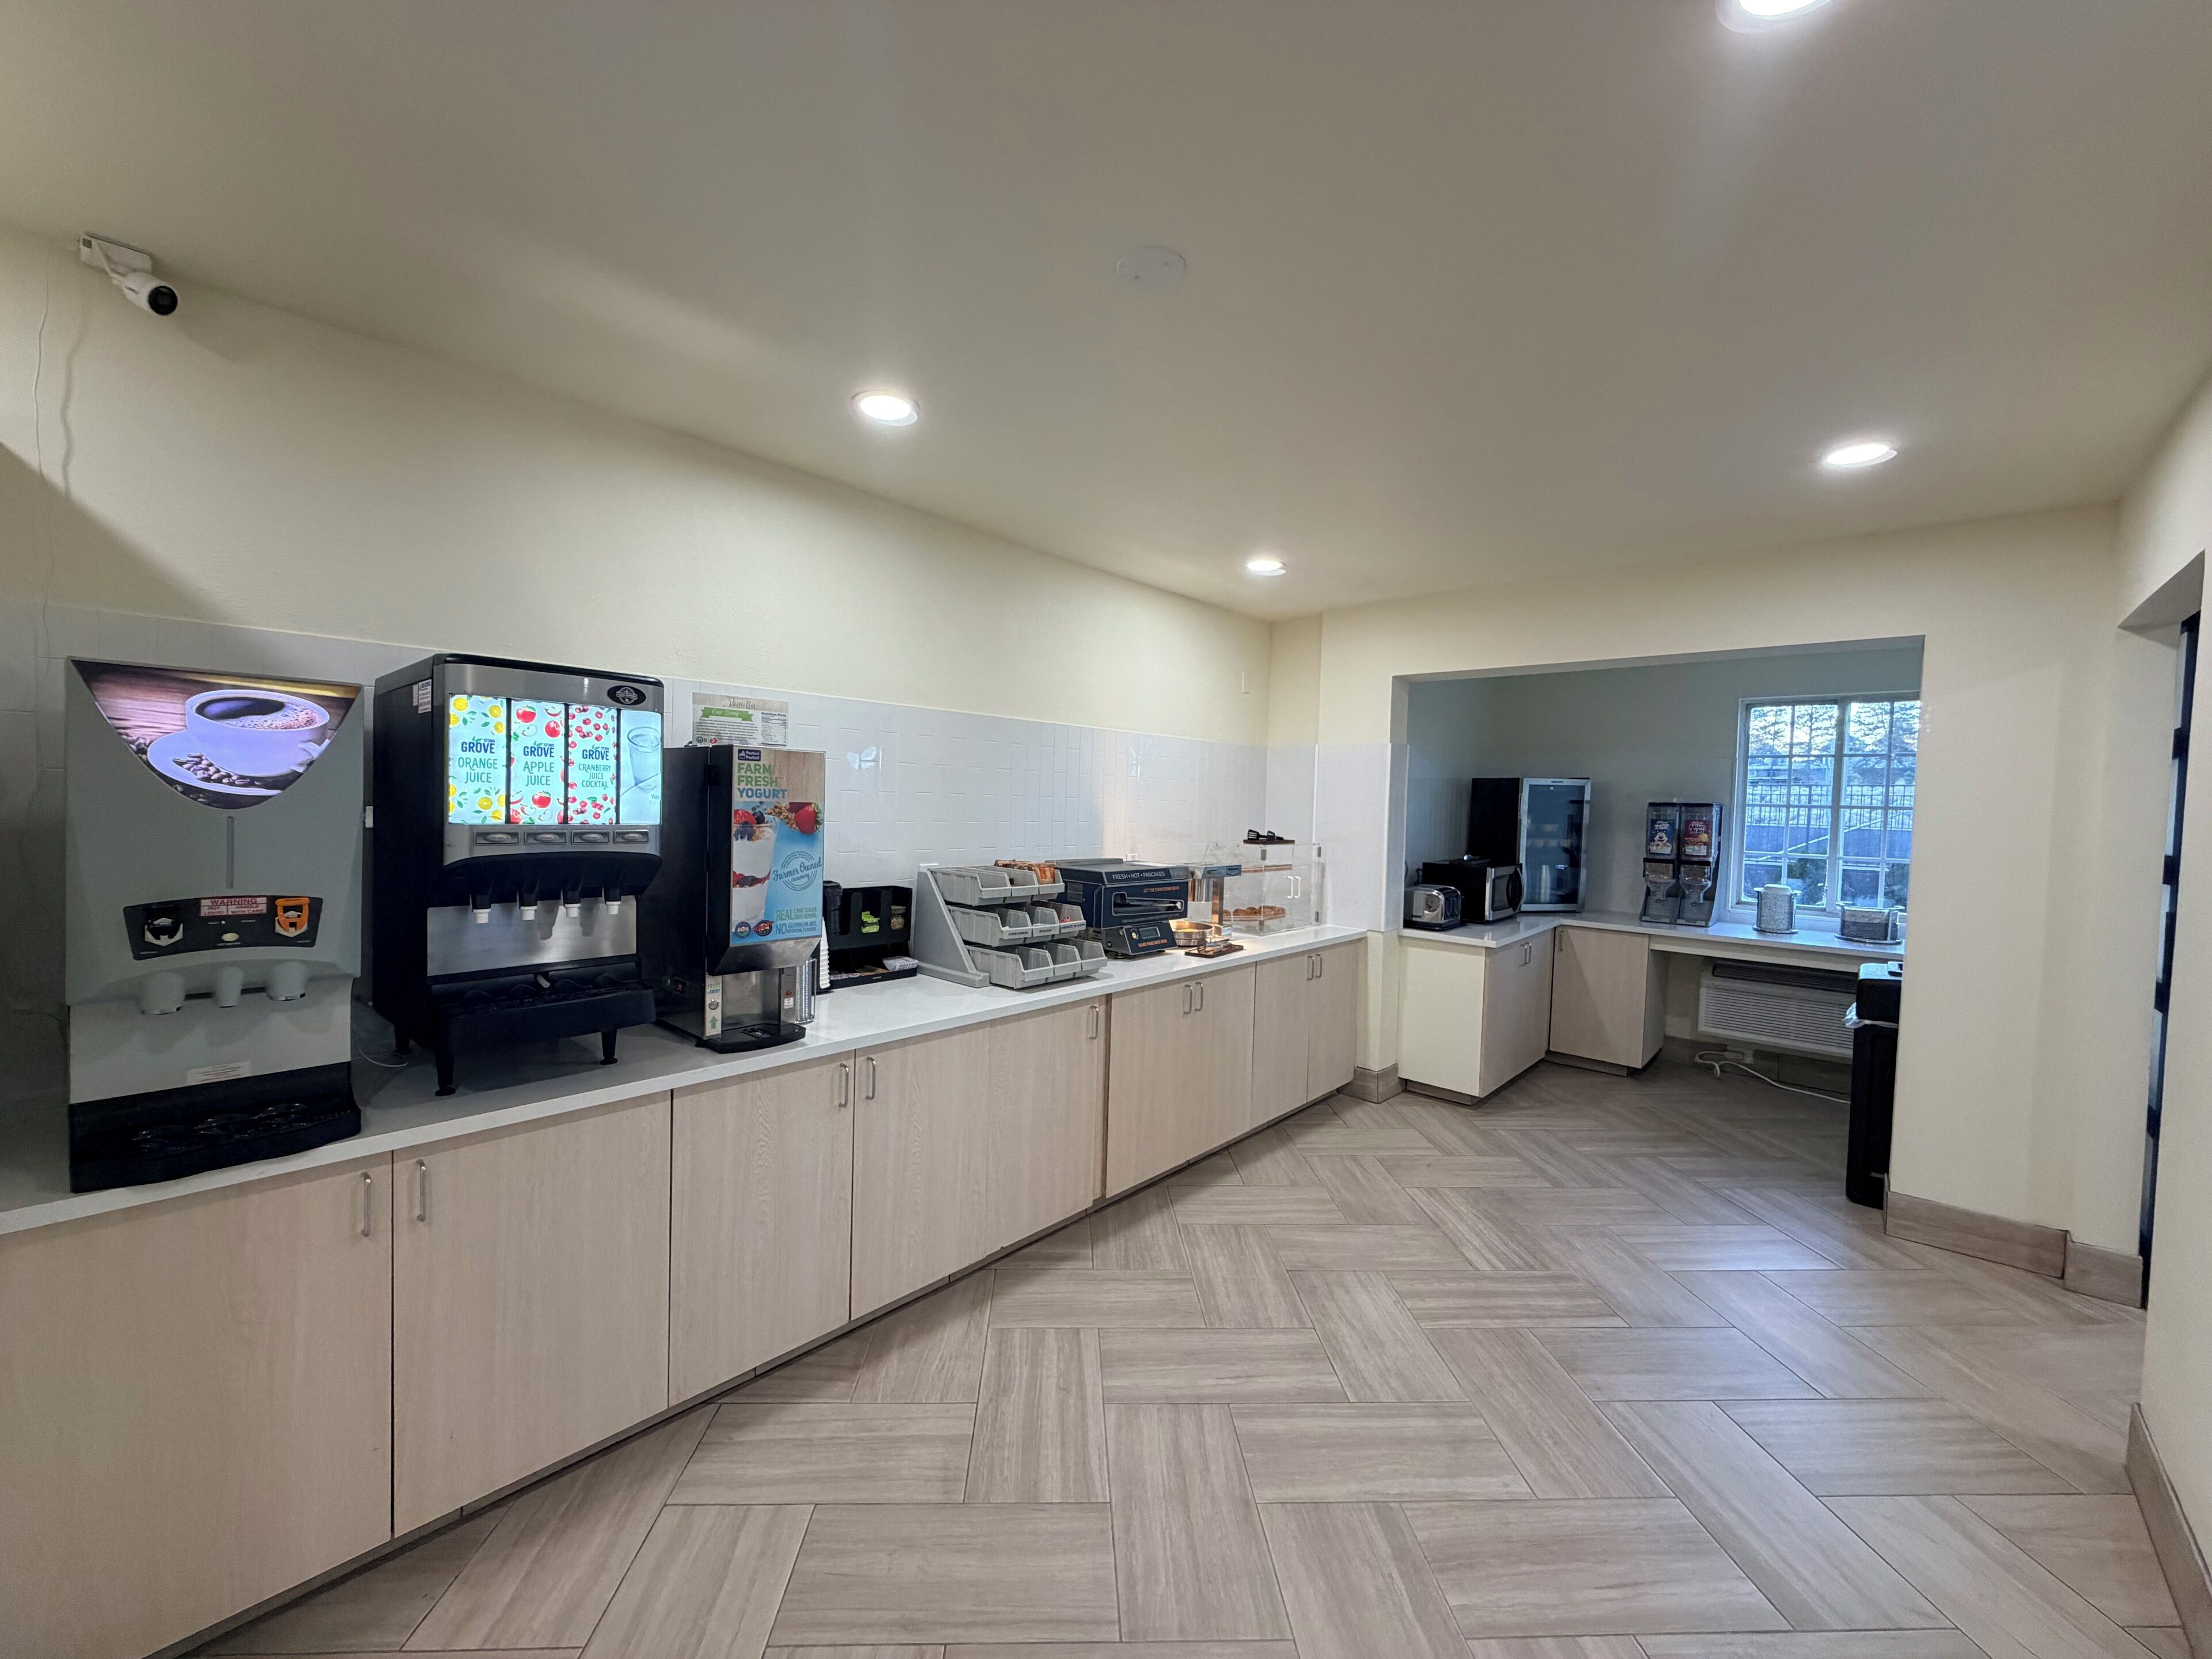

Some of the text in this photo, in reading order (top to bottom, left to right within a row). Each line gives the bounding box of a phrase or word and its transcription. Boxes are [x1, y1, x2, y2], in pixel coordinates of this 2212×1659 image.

[723, 698, 756, 710] Vanilla
[461, 741, 495, 754] GROVE
[523, 746, 555, 758] GROVE
[582, 749, 609, 760] GROVE
[458, 757, 498, 771] ORANGE
[523, 761, 555, 774] APPLE
[578, 763, 611, 773] CRANBERRY
[737, 763, 772, 775] FARM
[464, 772, 492, 784] JUICE
[525, 775, 551, 787] JUICE
[737, 775, 779, 787] FRESH
[582, 780, 608, 790] COCKTAIL
[737, 787, 787, 799] YOGURT
[773, 857, 822, 881] Farmer Owned
[776, 909, 794, 921] REAL
[776, 924, 787, 934] NO
